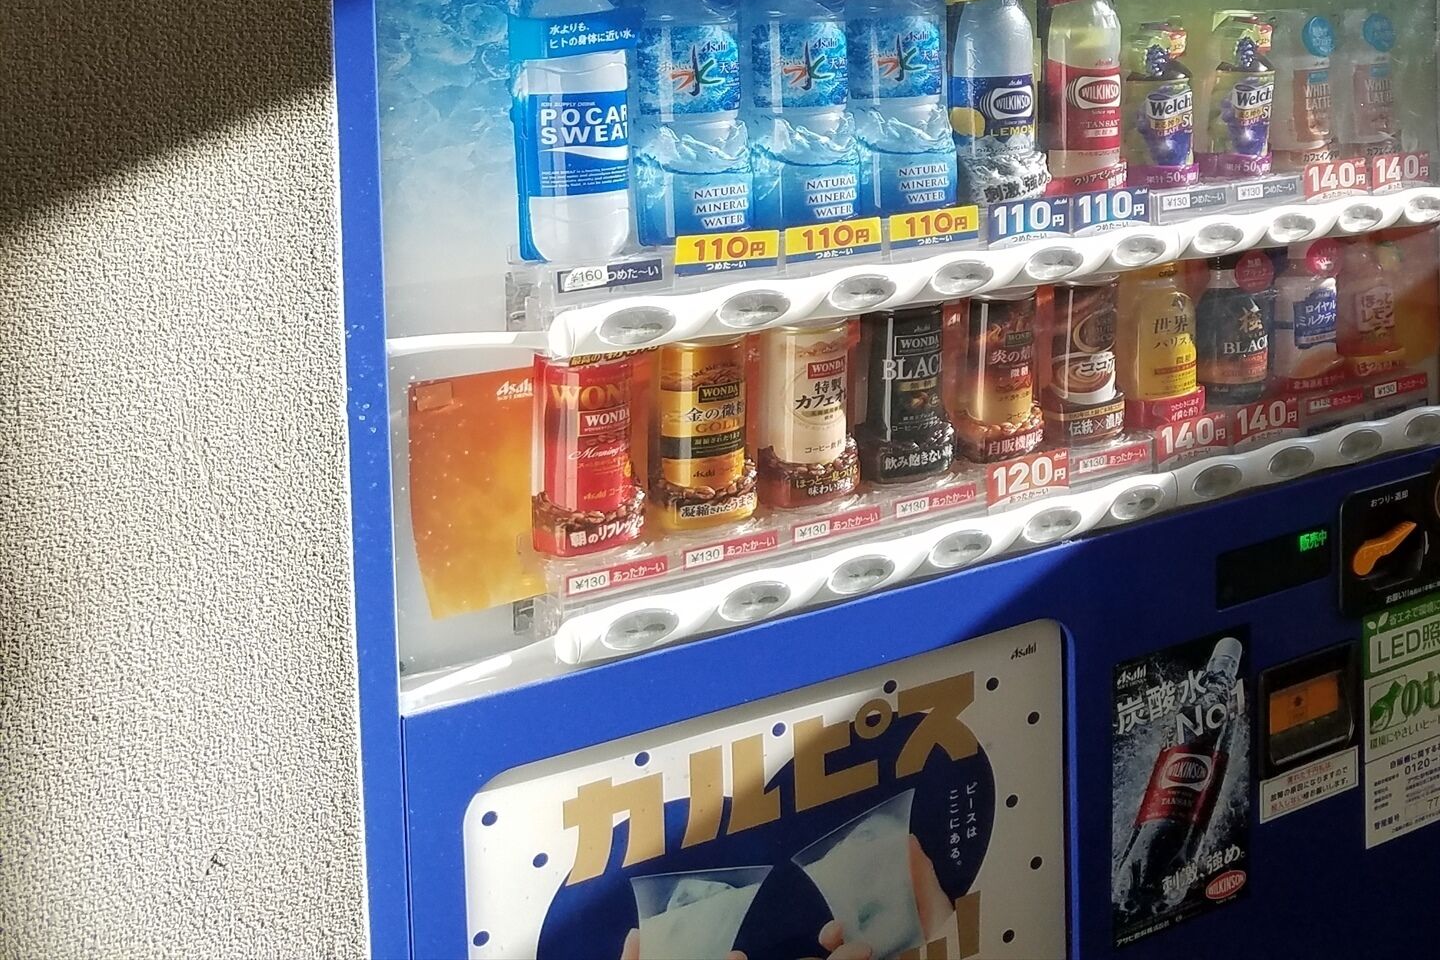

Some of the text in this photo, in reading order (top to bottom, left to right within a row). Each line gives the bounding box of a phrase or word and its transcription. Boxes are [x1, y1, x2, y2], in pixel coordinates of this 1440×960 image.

[549, 28, 636, 50] ヒトの身体に近い水。
[701, 40, 730, 54] Asahi
[814, 37, 839, 50] Asahi
[906, 30, 931, 42] Asahi
[783, 40, 835, 92] 水
[877, 33, 927, 82] 水
[670, 43, 726, 97] 水
[898, 163, 949, 178] NATURAL
[1308, 161, 1367, 193] 140円
[1375, 154, 1430, 184] 140円
[693, 183, 748, 201] NATURAL
[806, 174, 857, 191] NATURAL
[900, 177, 949, 191] MINERAL
[695, 199, 748, 216] MINERAL
[807, 189, 857, 205] MINERAL
[907, 191, 945, 204] WATER
[1077, 190, 1146, 223] 110円
[1166, 194, 1188, 206] ¥130
[815, 203, 853, 219] WATER
[993, 200, 1065, 236] 110円
[703, 214, 745, 231] WATER
[904, 211, 968, 239] 110円
[693, 236, 766, 262] 110円
[802, 224, 870, 252] 110円
[1305, 299, 1337, 314] ロイヤル
[900, 336, 939, 349] WONDA
[811, 359, 846, 374] WONDA
[702, 383, 739, 399] WONDA
[814, 376, 843, 395] 特製
[1376, 383, 1396, 396] ¥130
[585, 408, 631, 427] WONDA
[1239, 399, 1298, 430] 140円
[987, 428, 1044, 457] 自販機限定
[1161, 417, 1227, 455] 140円
[884, 448, 954, 471] 飲み飽きない味
[991, 455, 1067, 498] 120円
[680, 493, 756, 518] 凝縮されたうまさ
[899, 499, 927, 514] ¥130
[799, 523, 828, 539] ¥130
[1299, 528, 1328, 553] 販売中
[691, 548, 721, 564] ¥130
[575, 573, 607, 591] ¥130
[1010, 641, 1038, 660] Asahi
[1116, 664, 1147, 686] Asahi
[1116, 668, 1208, 736] 炭酸水
[1175, 678, 1246, 744] No.1
[561, 670, 980, 888] カルピス
[965, 781, 979, 840] ピースは
[948, 788, 962, 867] ここにある。
[1161, 842, 1246, 895] 刺激、強め。
[1207, 873, 1245, 897] WILKINSON
